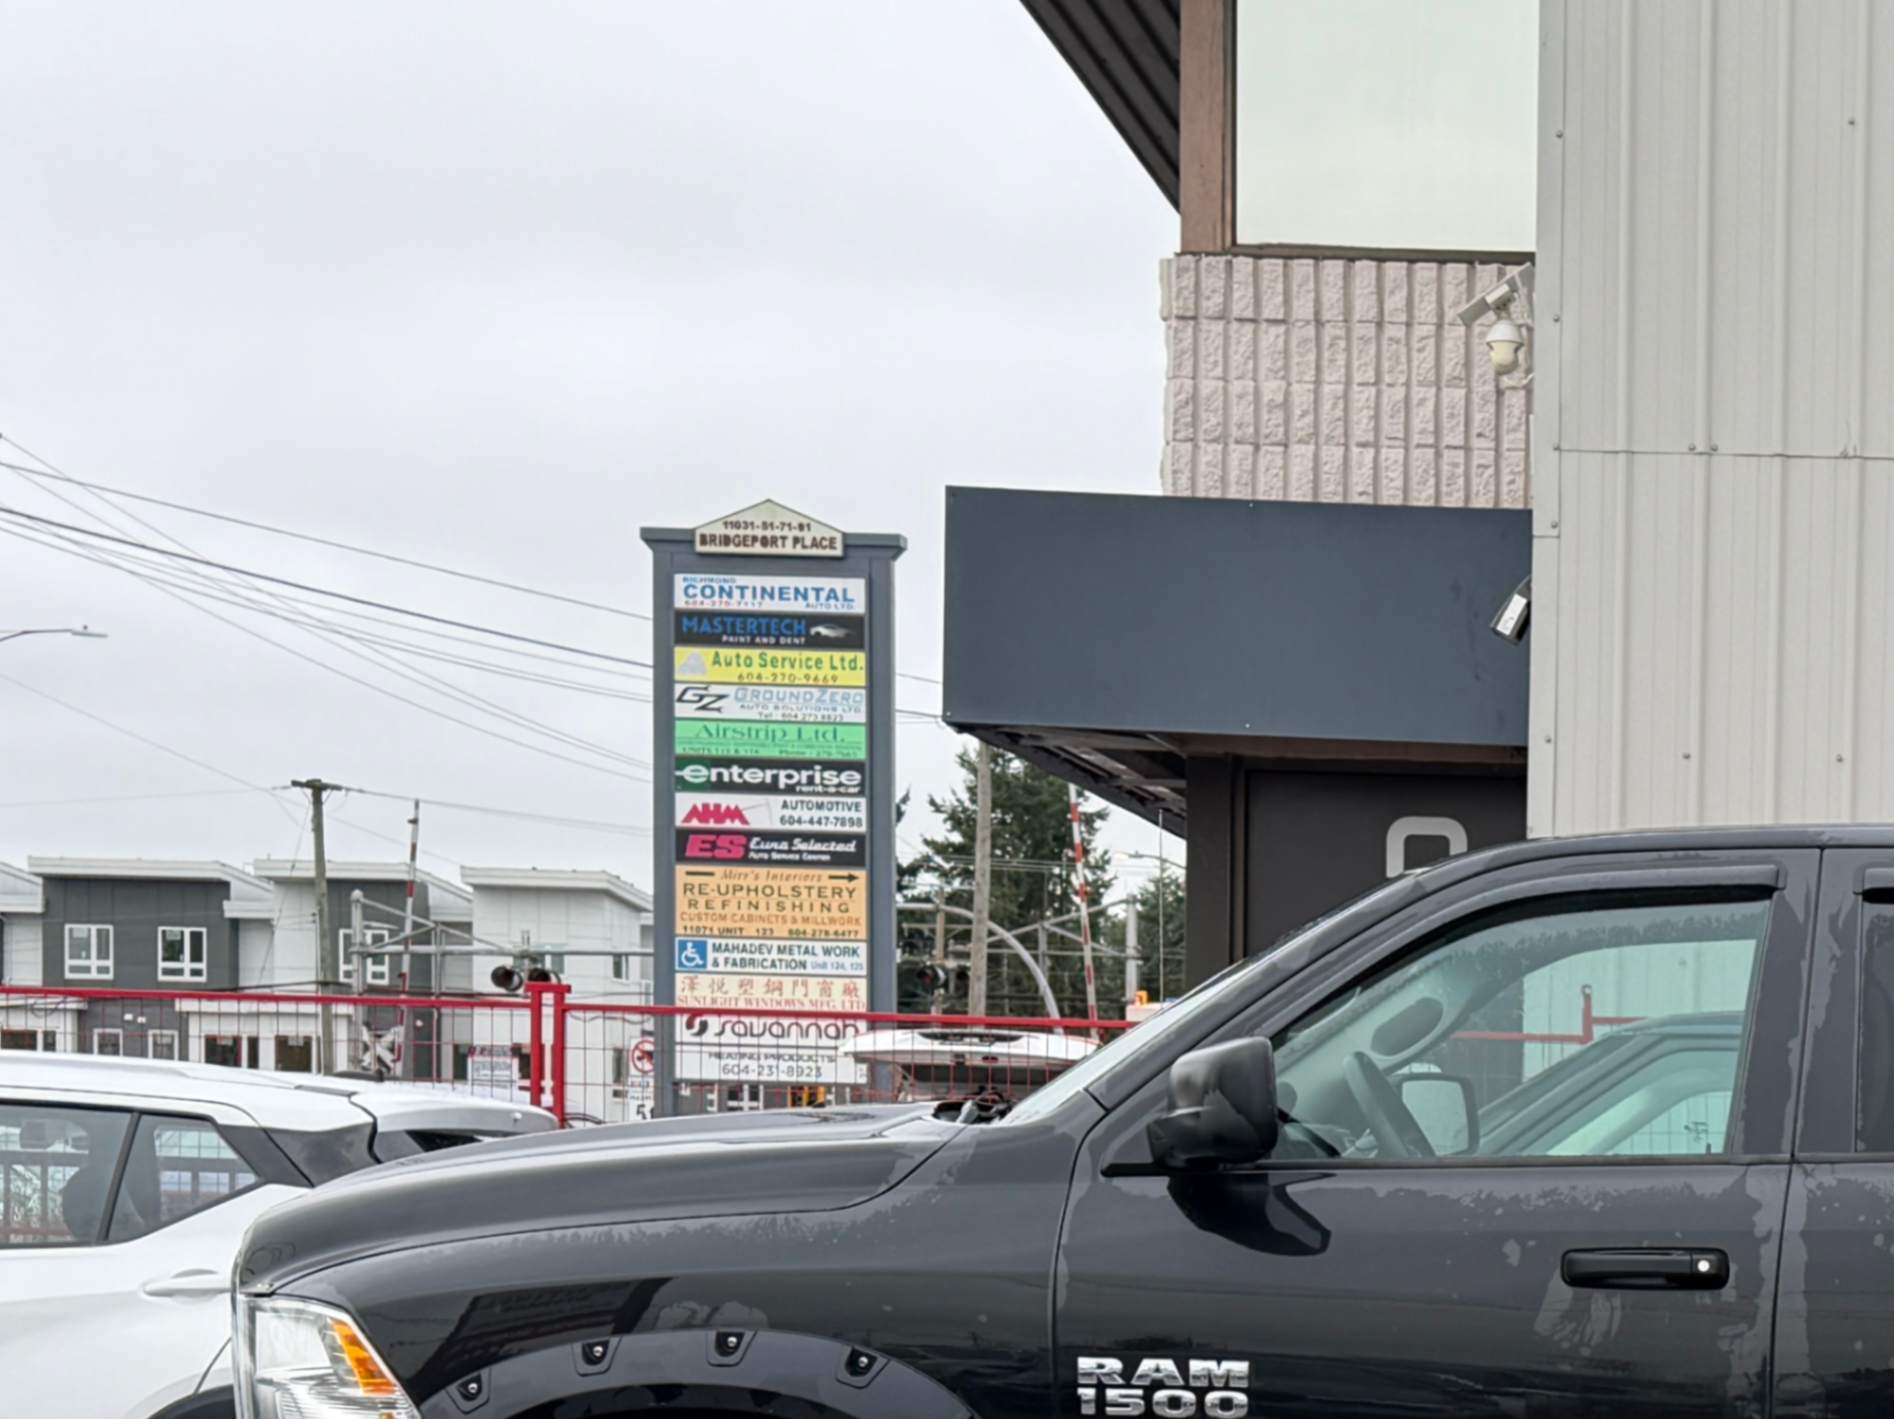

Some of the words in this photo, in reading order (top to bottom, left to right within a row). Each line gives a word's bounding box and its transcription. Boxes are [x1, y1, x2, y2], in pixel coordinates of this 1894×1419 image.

[699, 533, 788, 549] BRIDGEPORT
[792, 535, 837, 550] PLACE
[683, 584, 855, 603] CONTINENTAL
[682, 616, 806, 635] MASTERTECH
[721, 635, 751, 644] PAINT
[755, 636, 776, 645] AND
[779, 637, 806, 645] DENT
[712, 651, 753, 668] Auto
[758, 651, 823, 670] Service
[829, 654, 864, 671] Ltd.
[739, 703, 770, 711] AUTO
[696, 724, 787, 743] Airstrip
[797, 726, 846, 743] Ltd.
[675, 765, 862, 789] enterprise
[796, 785, 861, 794] rent-a-car
[780, 800, 862, 812] AUTOMOTIVE
[780, 815, 863, 827] 604-447-7898
[685, 834, 748, 859] ES
[749, 837, 789, 850] Euro
[791, 838, 857, 852] Selected
[765, 870, 823, 883] Interiors
[683, 883, 857, 899] RE-UPHOLSTERY
[687, 899, 850, 913] REFINISHING
[680, 912, 728, 922] CUSTOM
[730, 913, 788, 924] CABINETS
[801, 915, 862, 926] MILLWORK
[718, 927, 745, 936] UNIT
[711, 942, 773, 955] MAHADEV
[777, 944, 818, 957] METAL
[821, 946, 860, 958] WORK
[712, 957, 719, 968] &
[724, 957, 807, 970] FABRICATION
[677, 995, 739, 1007] SUNLIGHT
[745, 997, 805, 1009] WINDOWS
[714, 1019, 859, 1040] savannah
[1077, 1356, 1250, 1388] RAM
[1077, 1387, 1249, 1419] 1500
